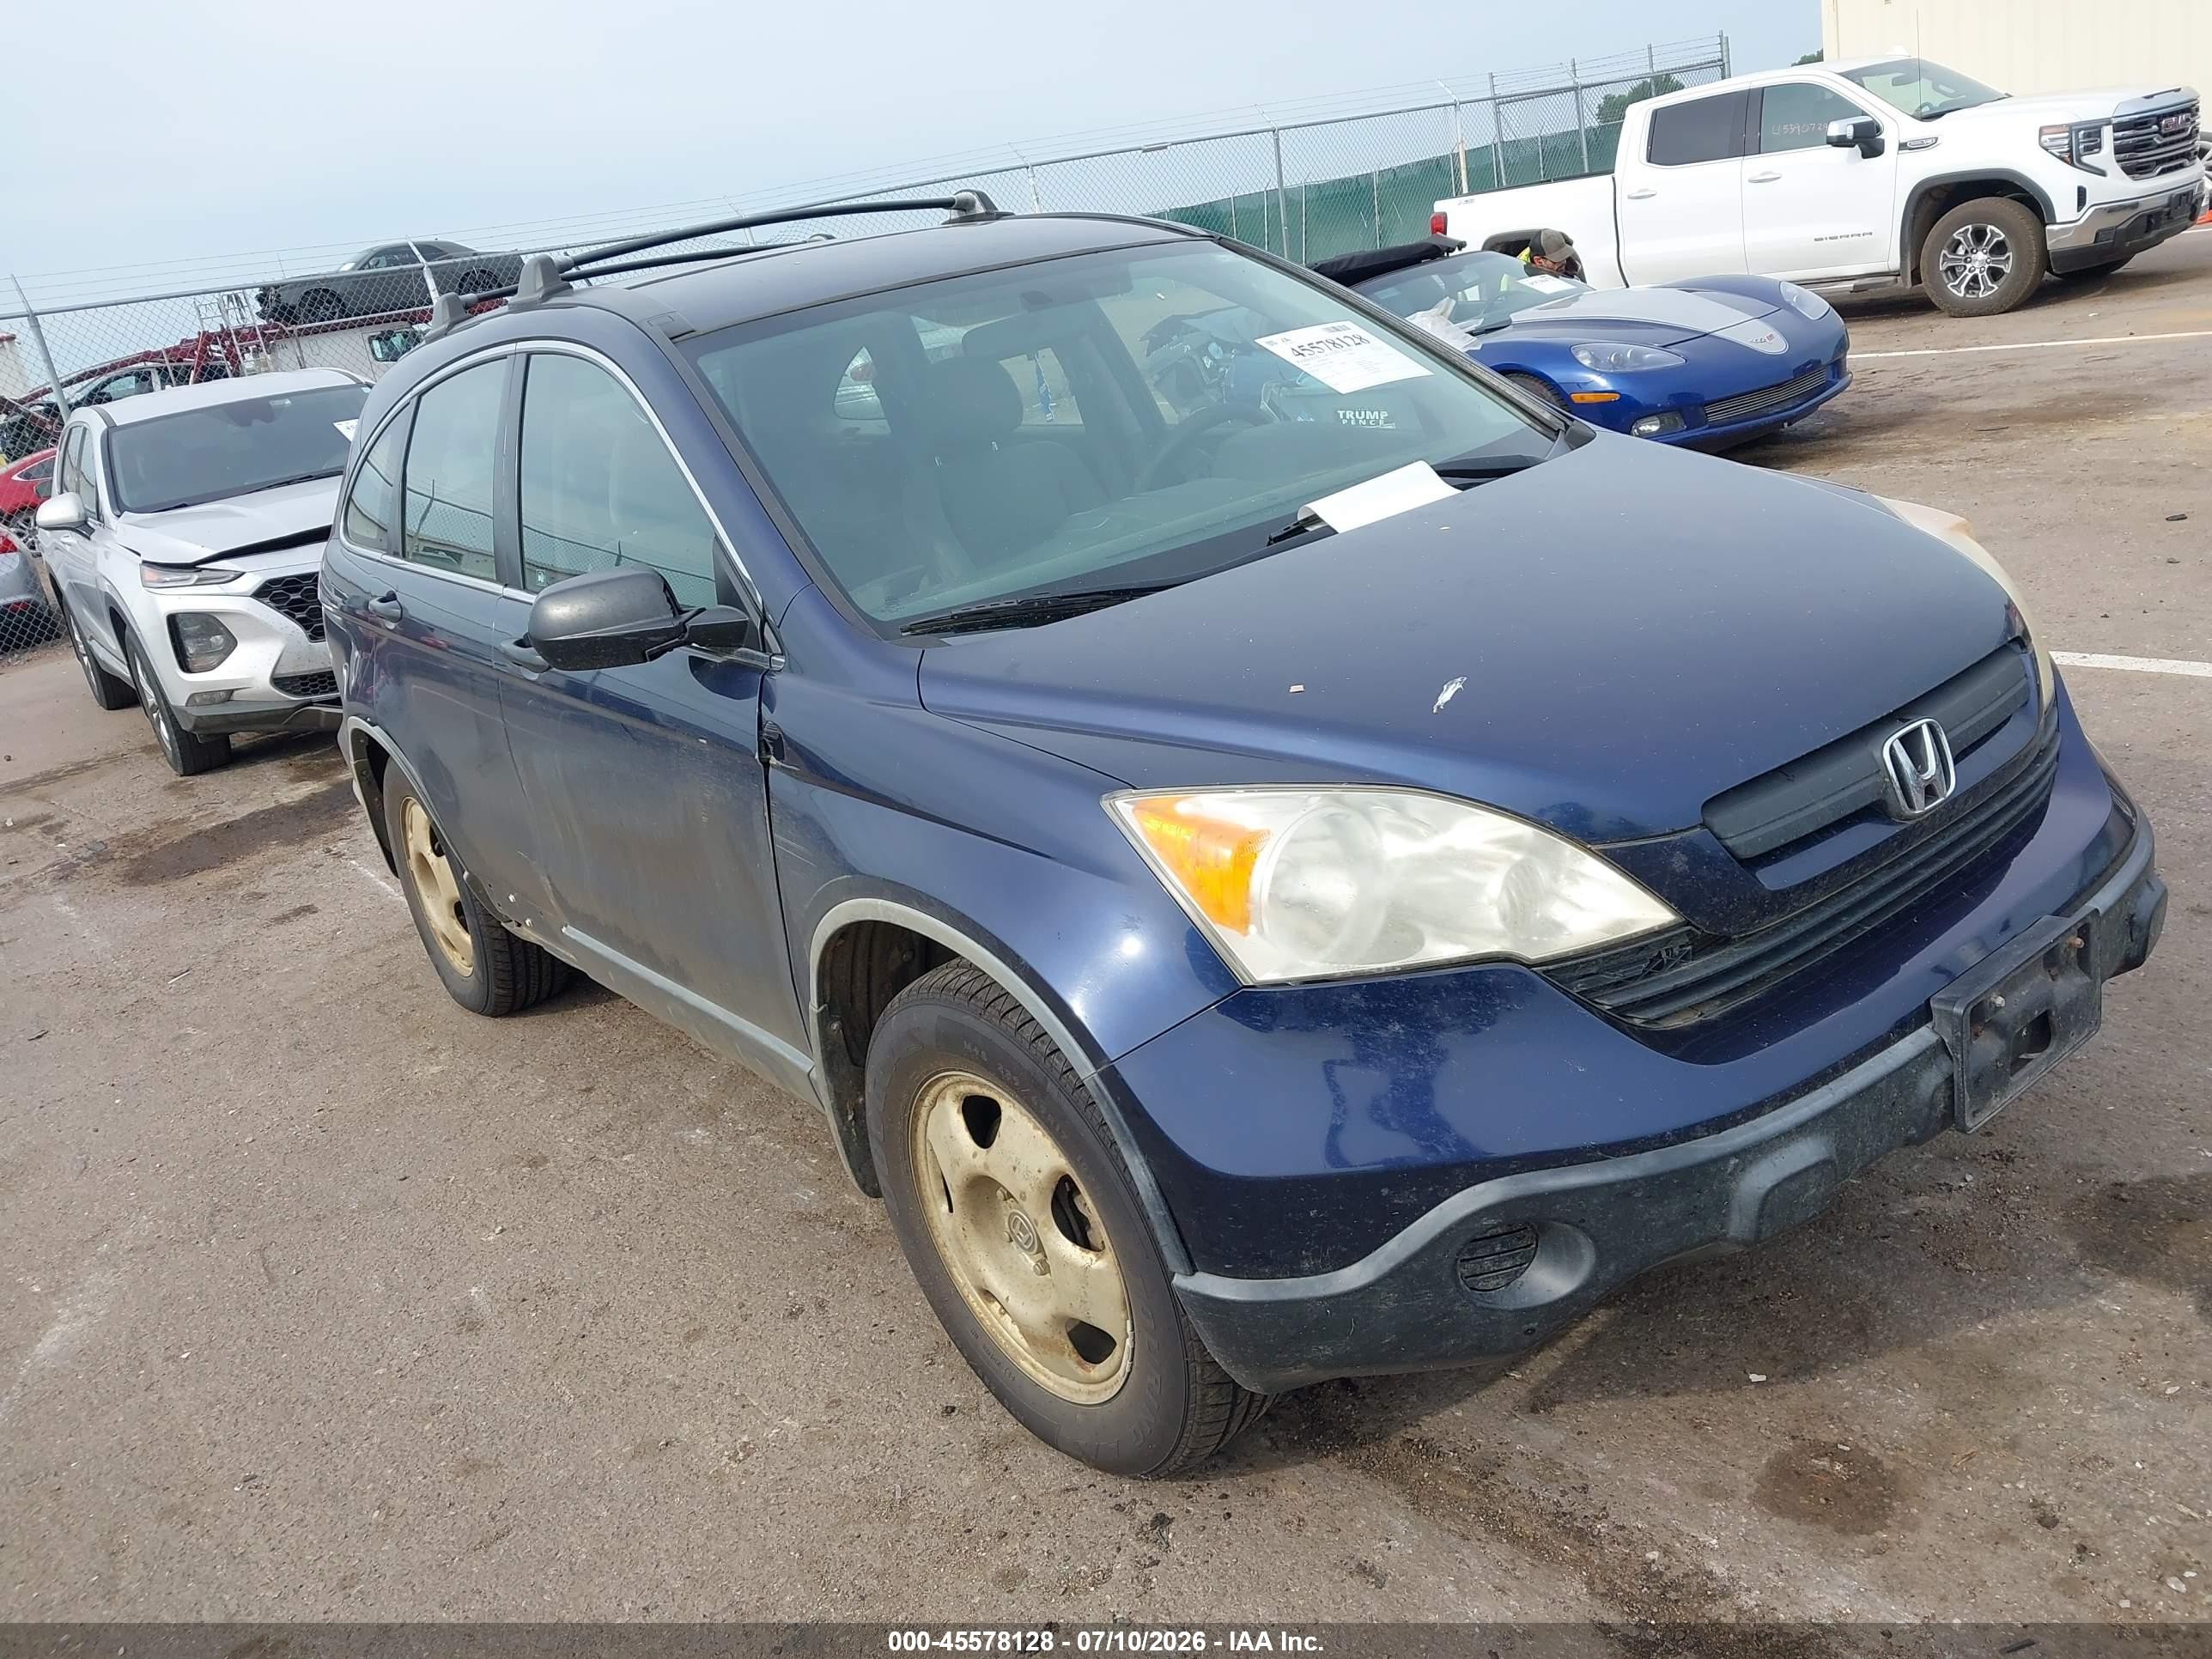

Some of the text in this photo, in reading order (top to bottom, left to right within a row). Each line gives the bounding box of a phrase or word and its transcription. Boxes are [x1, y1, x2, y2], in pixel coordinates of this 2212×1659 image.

[1814, 231, 1873, 241] SIERRA
[1291, 334, 1371, 358] 45578128
[1337, 410, 1389, 420] TRUMP
